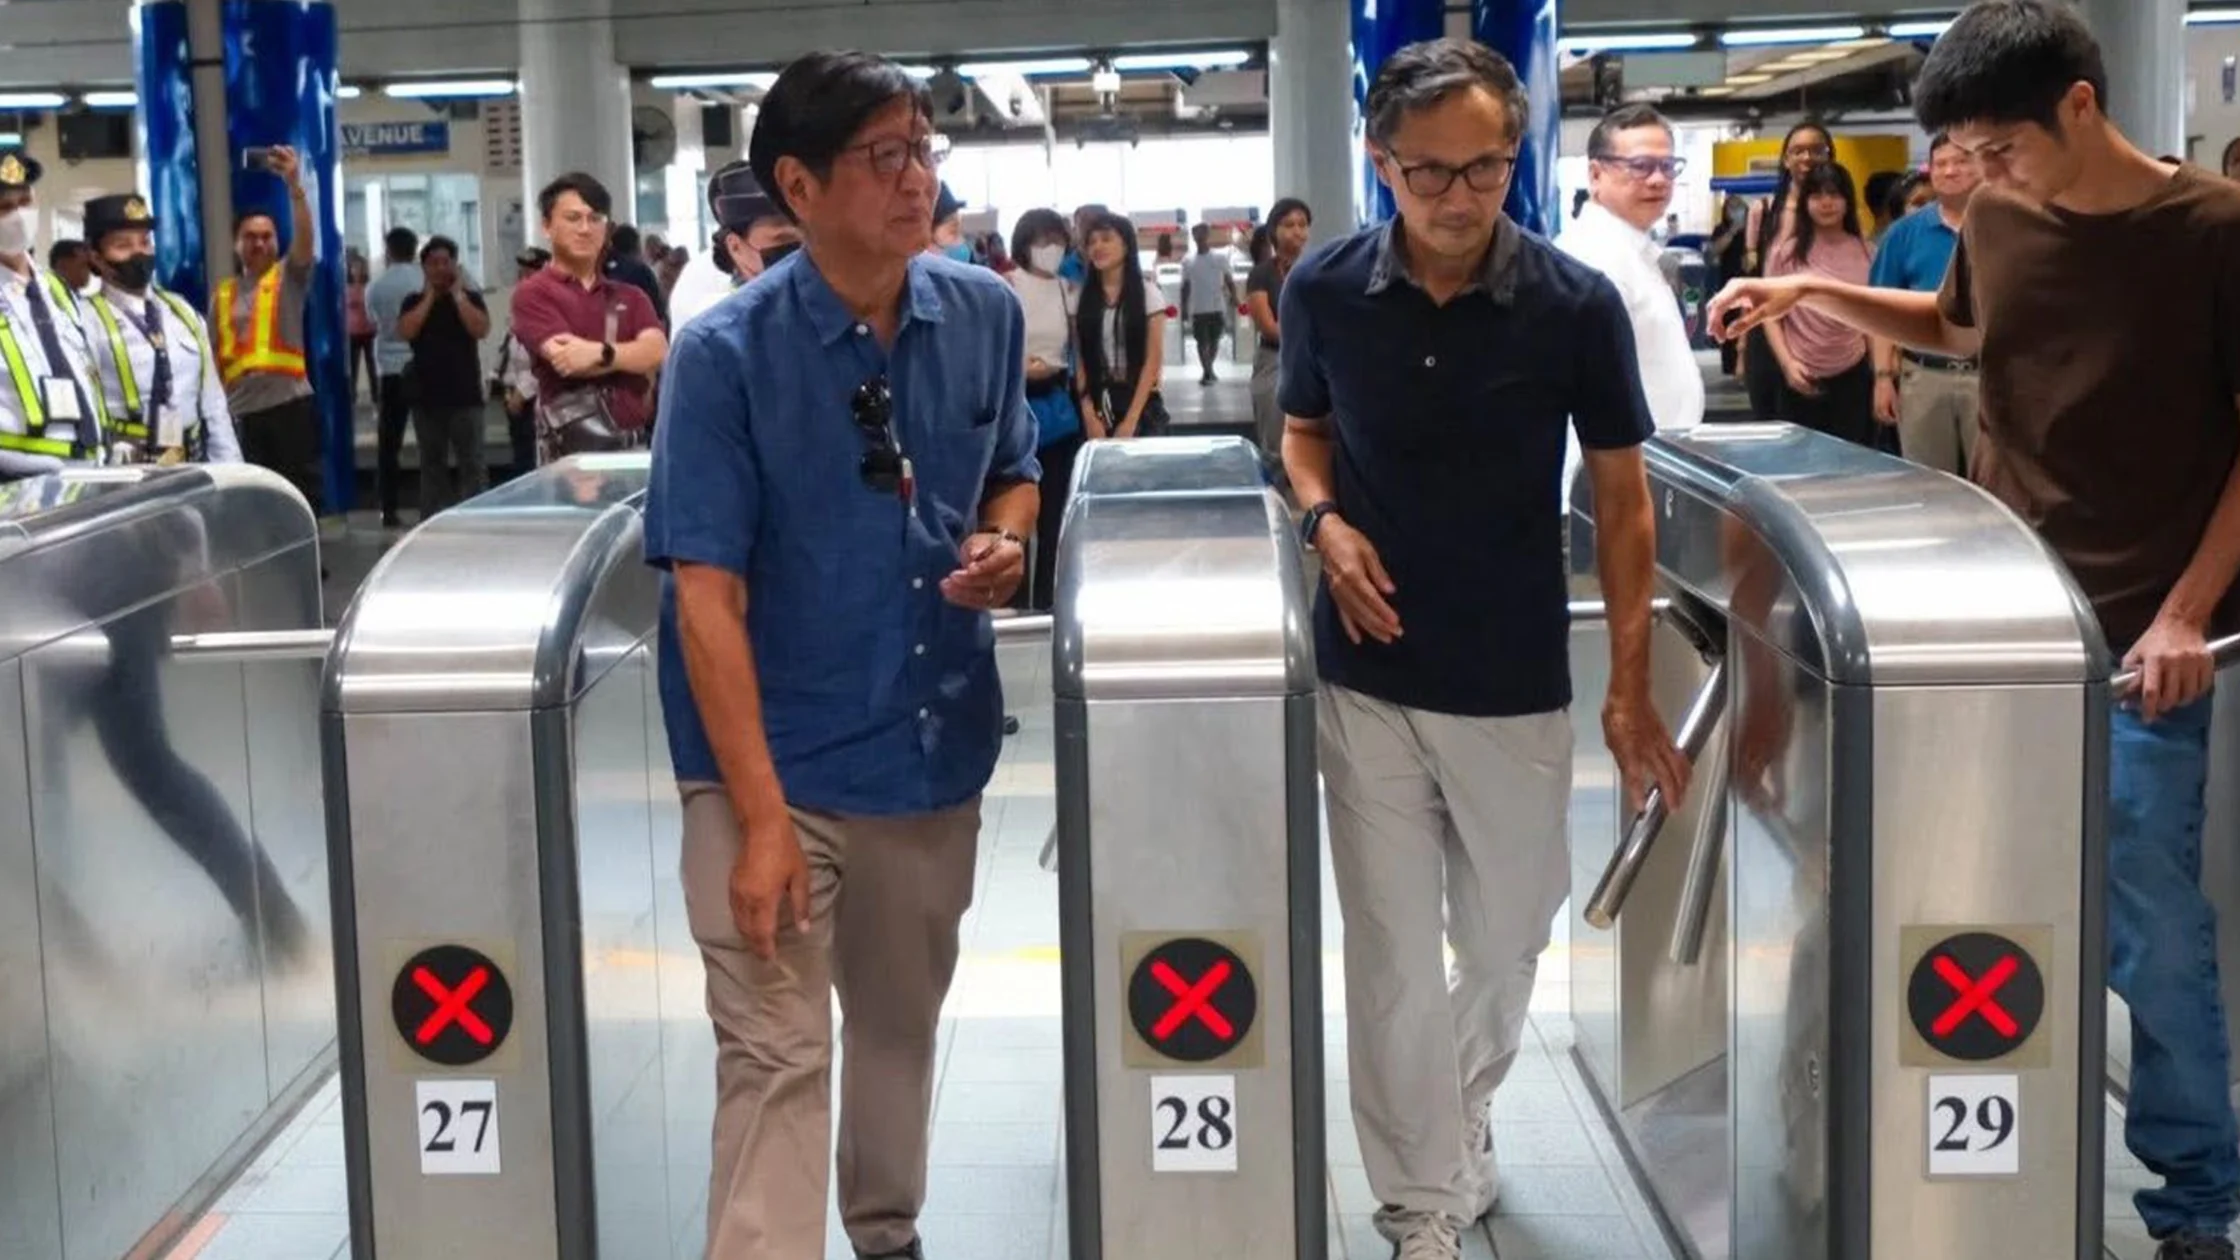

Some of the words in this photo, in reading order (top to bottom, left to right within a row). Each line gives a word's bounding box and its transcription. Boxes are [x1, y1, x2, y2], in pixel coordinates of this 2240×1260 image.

[422, 1099, 493, 1153] 27
[1156, 1095, 1233, 1151] 28
[1933, 1095, 2015, 1152] 29
